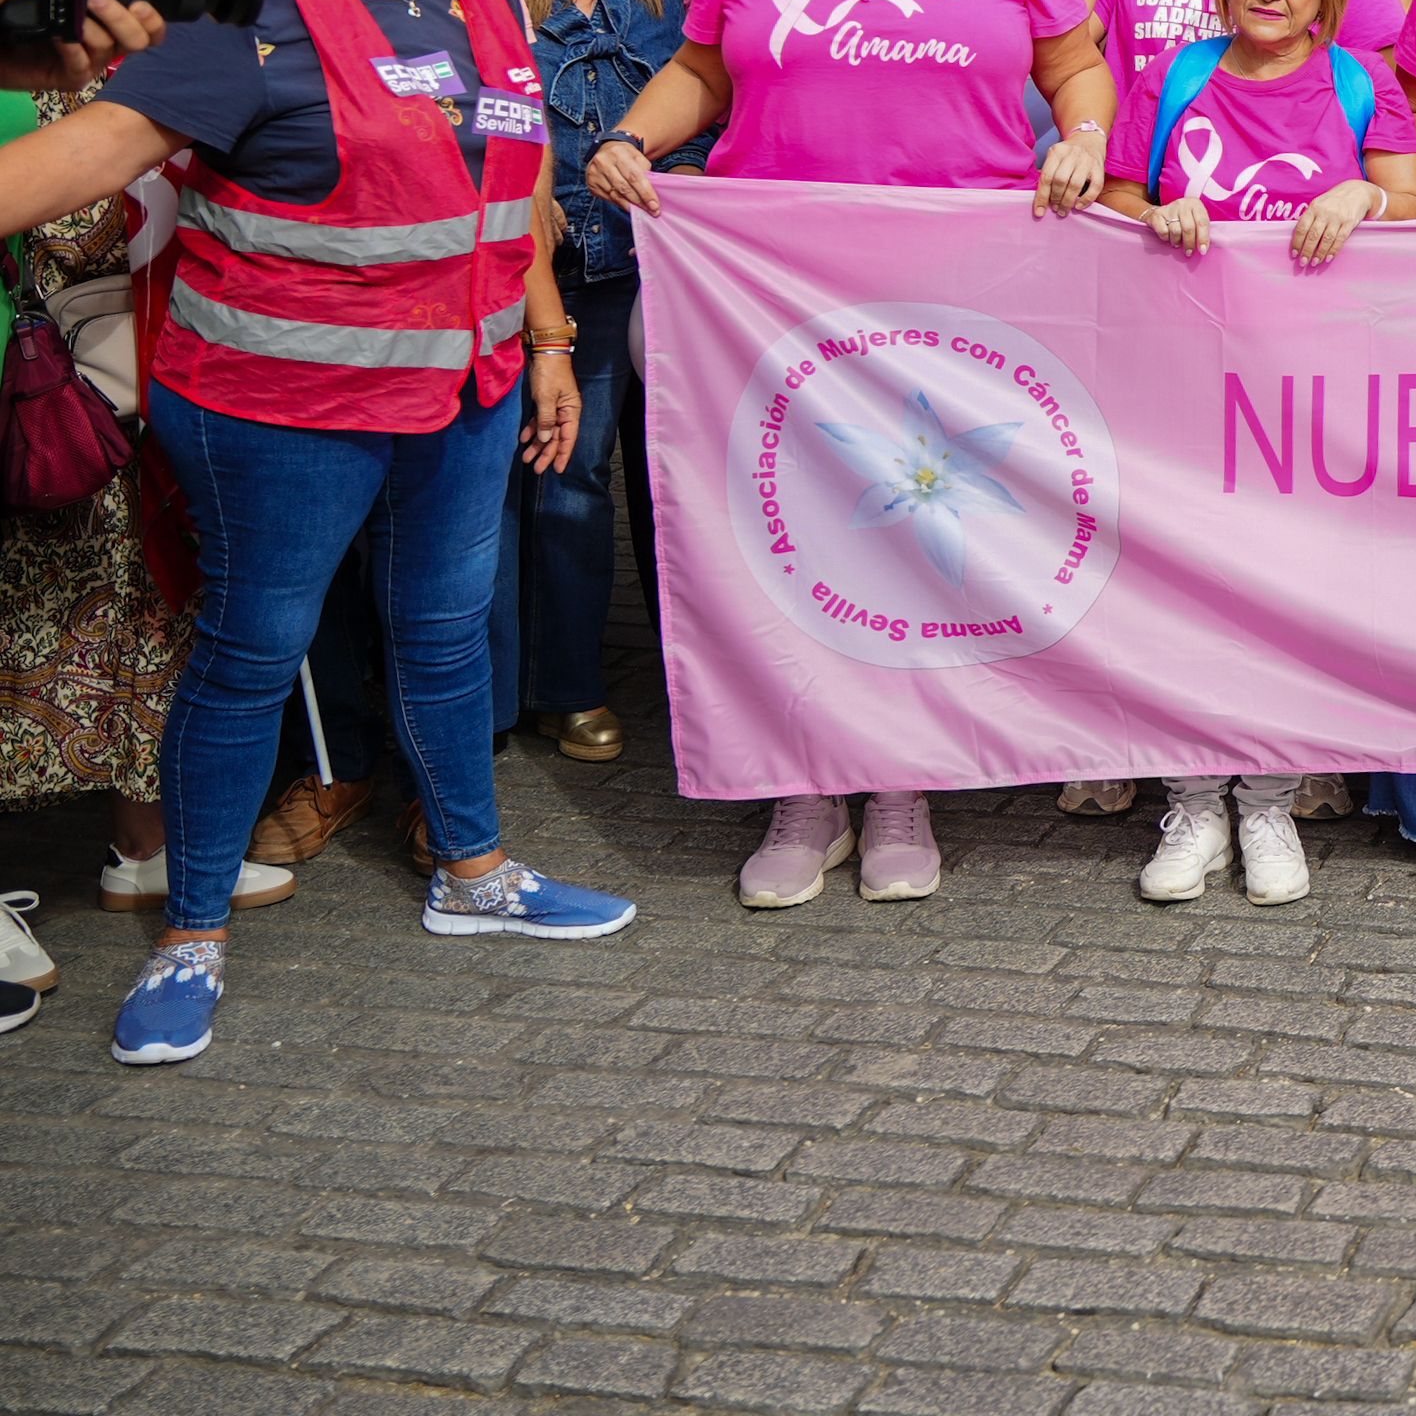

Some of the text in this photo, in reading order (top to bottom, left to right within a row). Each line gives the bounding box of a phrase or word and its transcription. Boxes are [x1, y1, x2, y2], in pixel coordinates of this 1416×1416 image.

[1153, 6, 1224, 32] ADMIR
[830, 20, 977, 68] Amama
[476, 115, 523, 134] Sevilla
[752, 328, 1098, 586] Asociación de Mujeres con Cáncer de Mama
[811, 580, 1024, 643] Amama Sevilla
